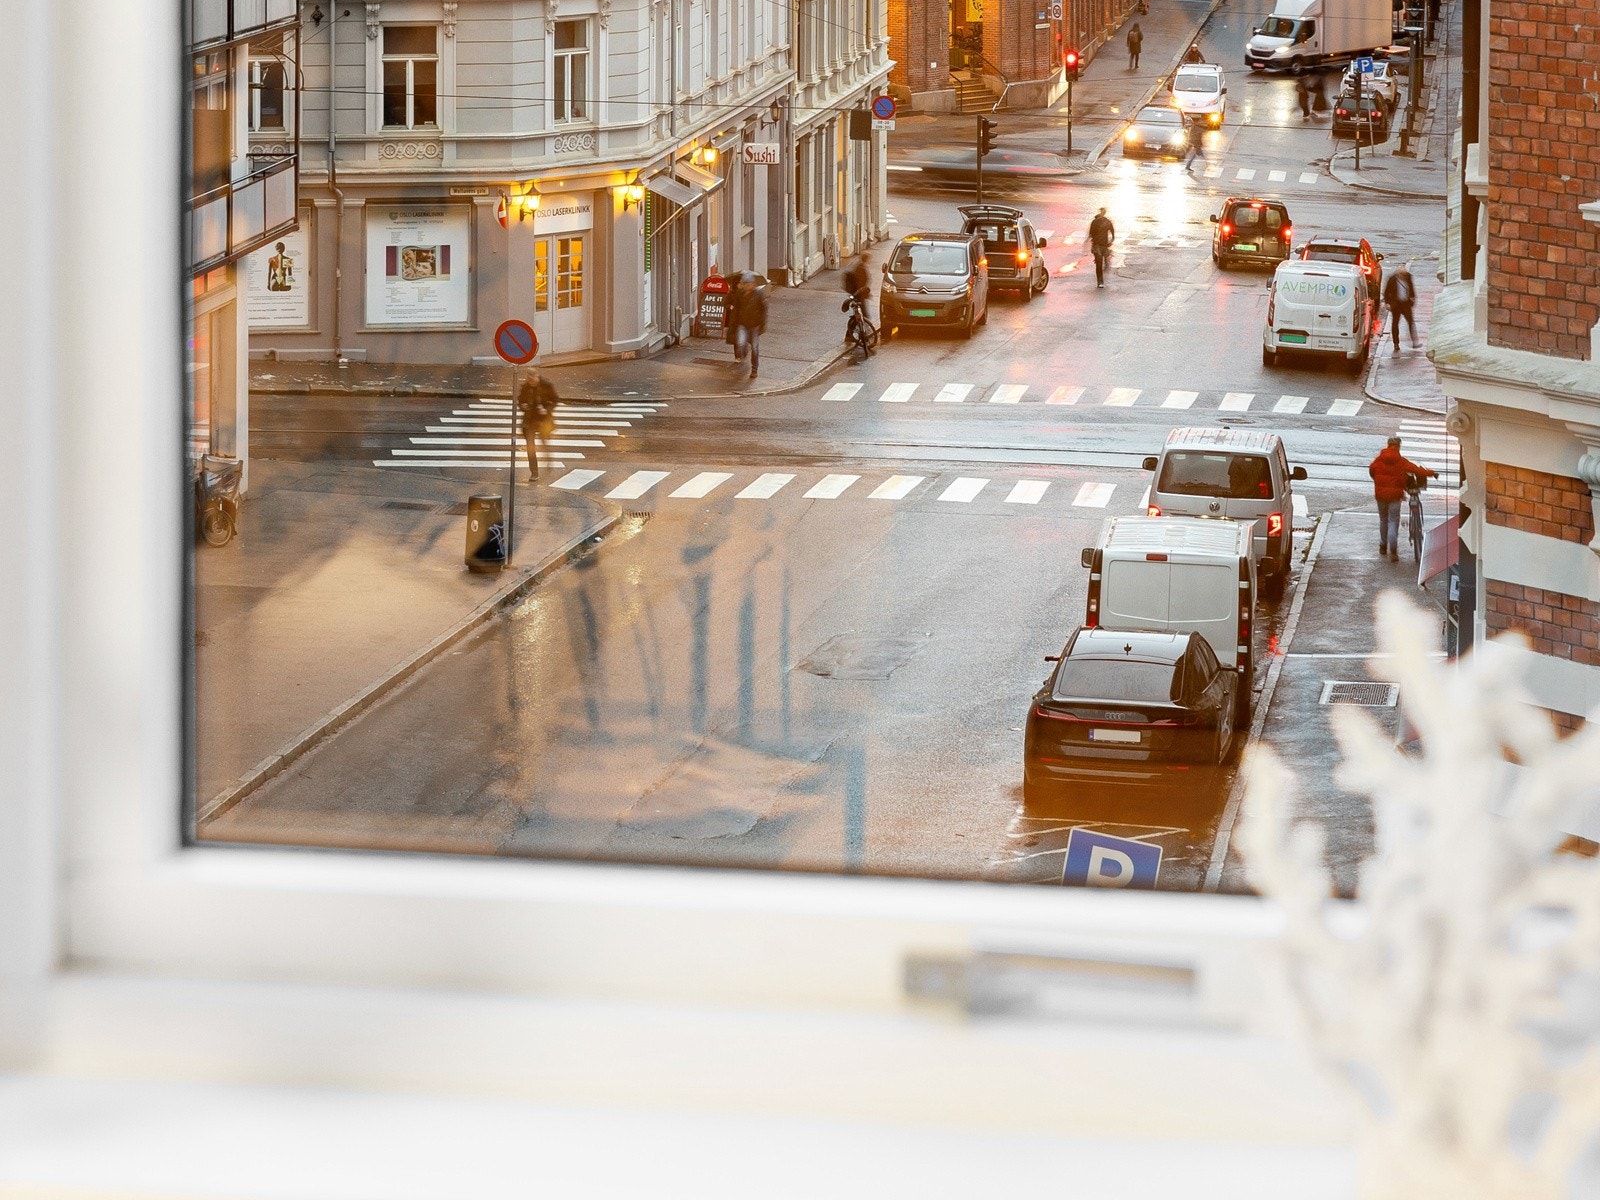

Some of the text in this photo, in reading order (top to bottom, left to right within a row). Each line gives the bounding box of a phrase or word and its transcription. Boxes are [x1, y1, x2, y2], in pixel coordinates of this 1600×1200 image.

[1361, 60, 1370, 71] P
[745, 146, 775, 162] Sushi
[537, 205, 591, 218] OSLO LASERKLINIKK
[701, 304, 725, 314] SUSHI
[1086, 845, 1135, 888] P
